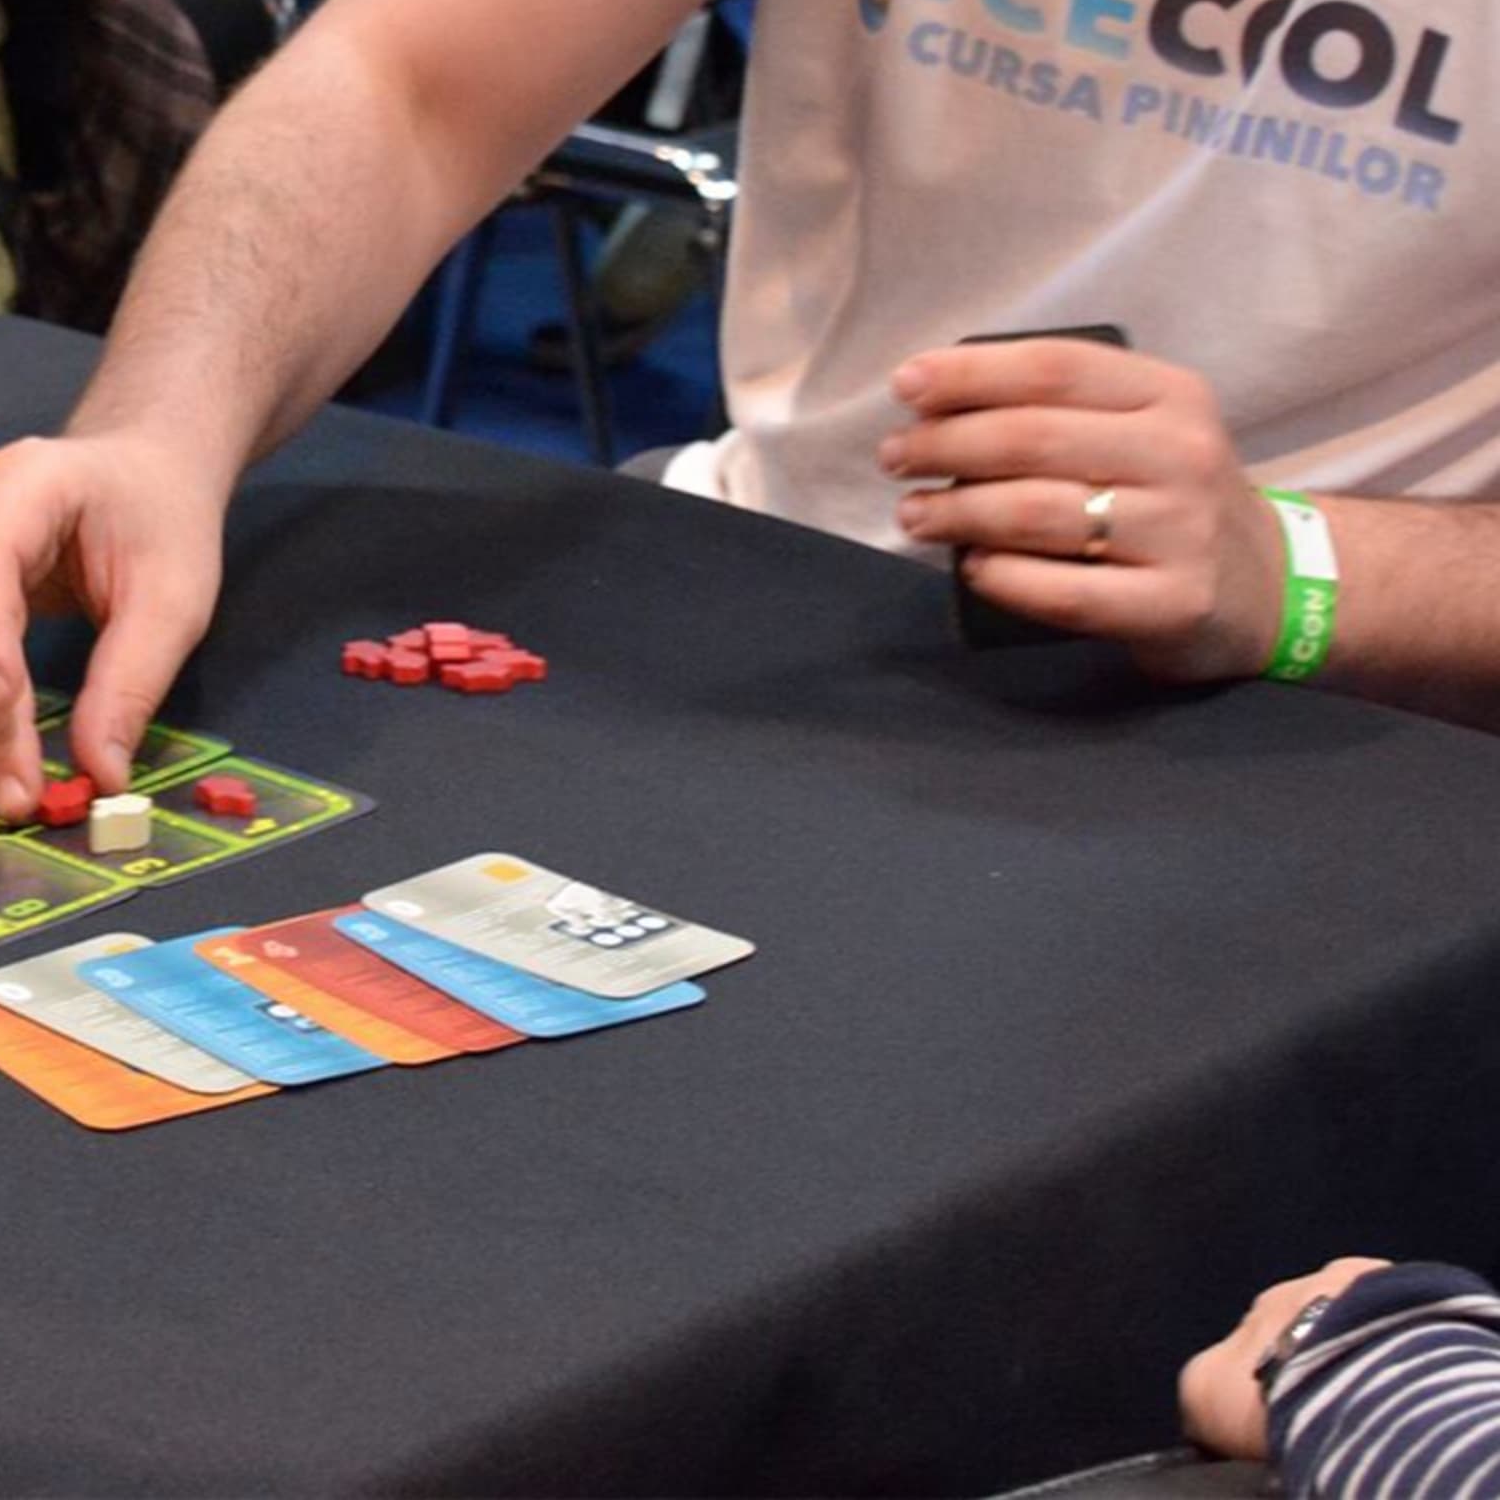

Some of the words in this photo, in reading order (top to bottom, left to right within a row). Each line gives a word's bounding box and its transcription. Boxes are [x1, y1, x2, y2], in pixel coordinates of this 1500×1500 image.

[907, 21, 1102, 122] CURSA
[1120, 82, 1446, 211] PININILOR
[121, 856, 169, 875] 3
